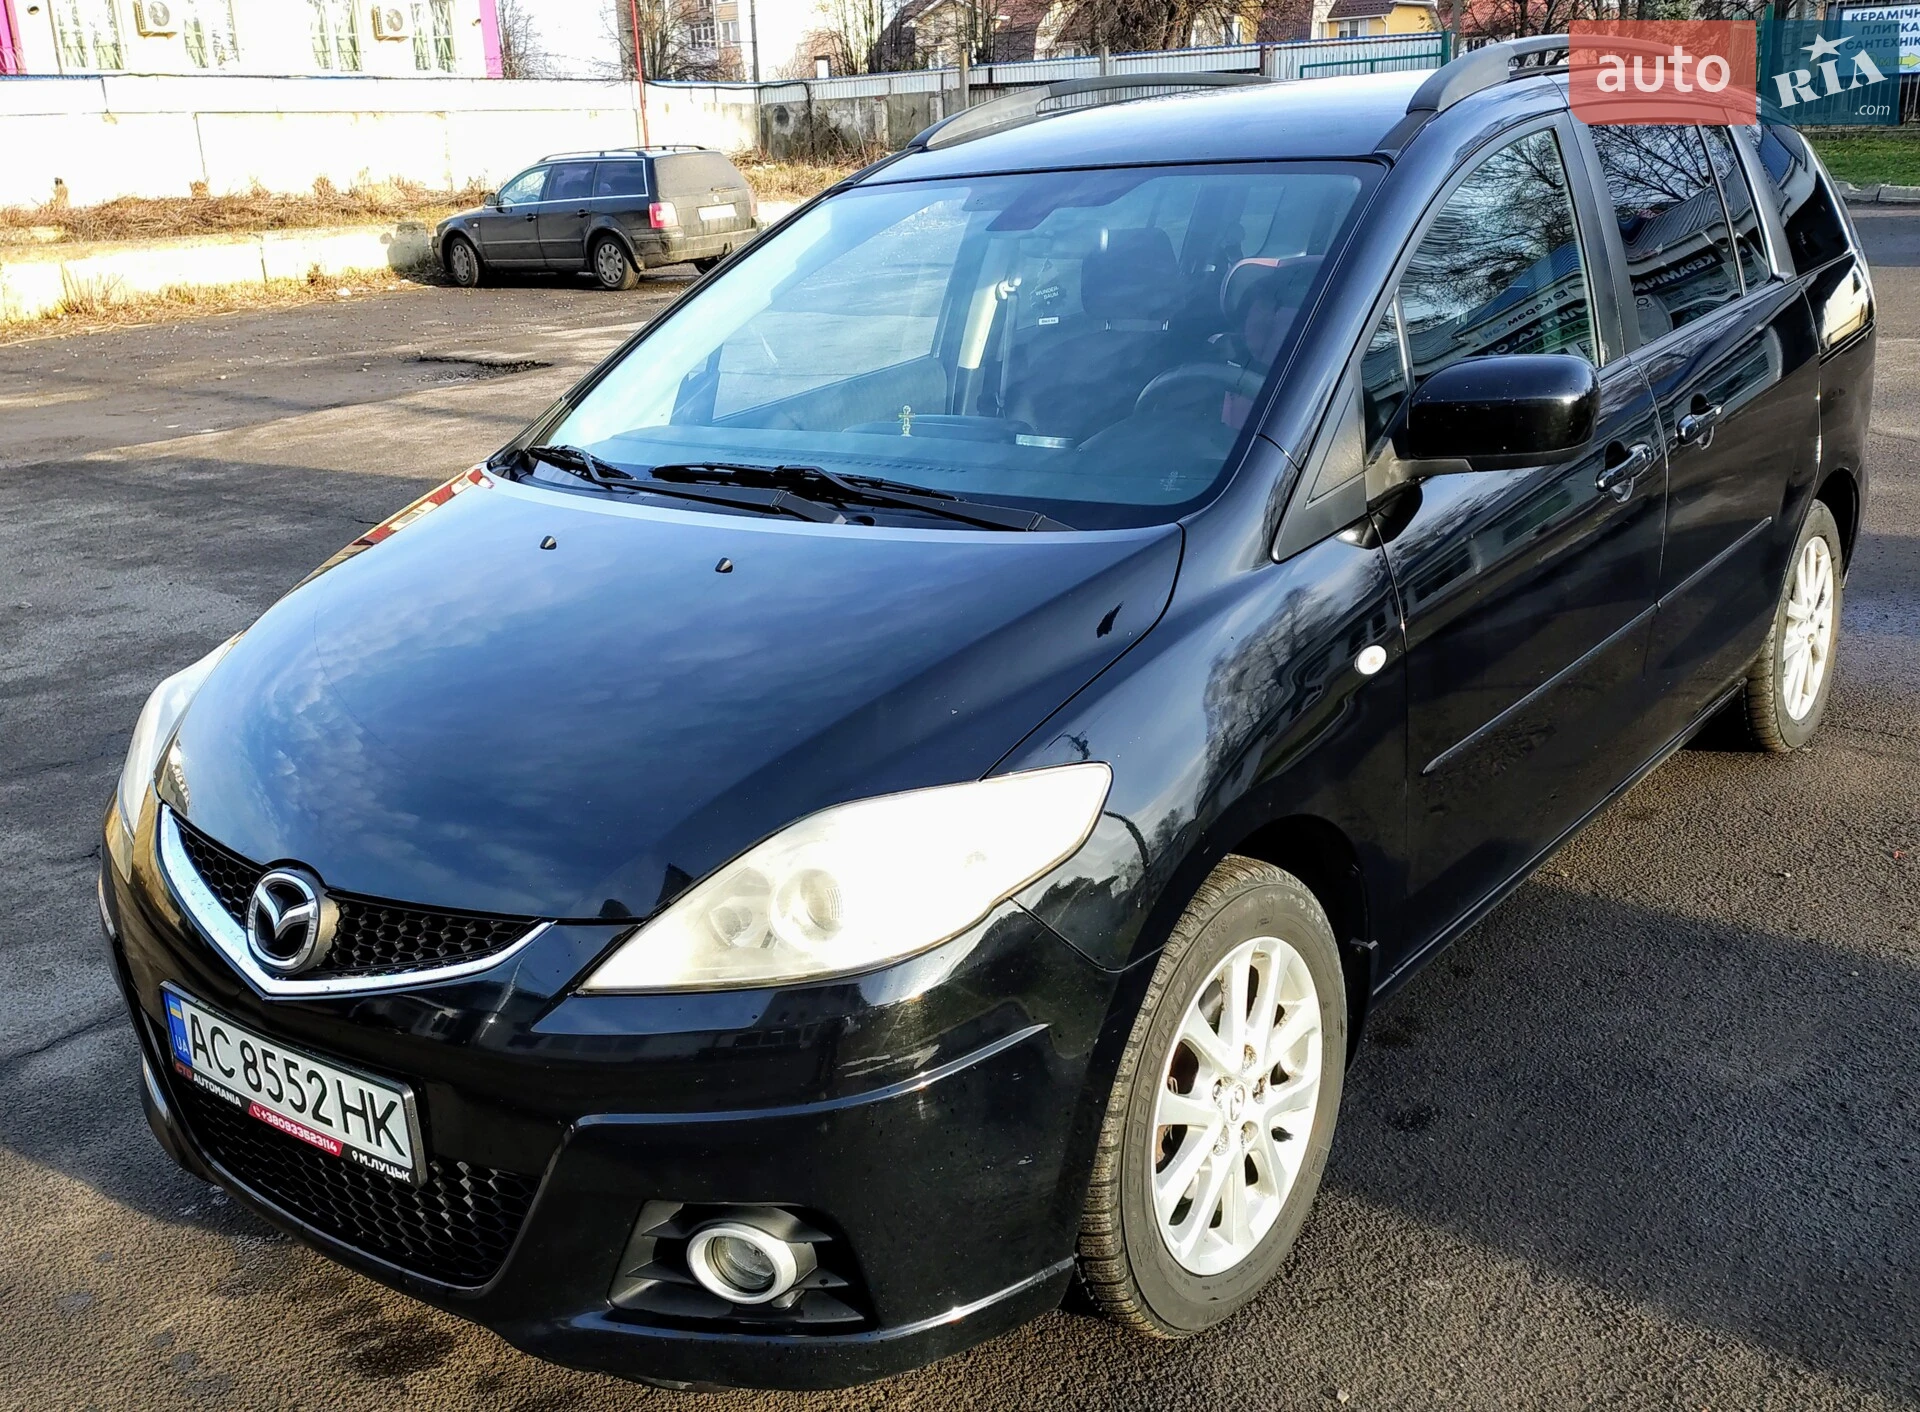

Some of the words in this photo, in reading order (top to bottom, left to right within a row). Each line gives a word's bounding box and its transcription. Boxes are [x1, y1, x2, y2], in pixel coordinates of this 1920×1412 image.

[1861, 22, 1920, 35] ПЛИТКА
[175, 1035, 189, 1056] UA
[193, 1076, 242, 1107] AUTOMANIA
